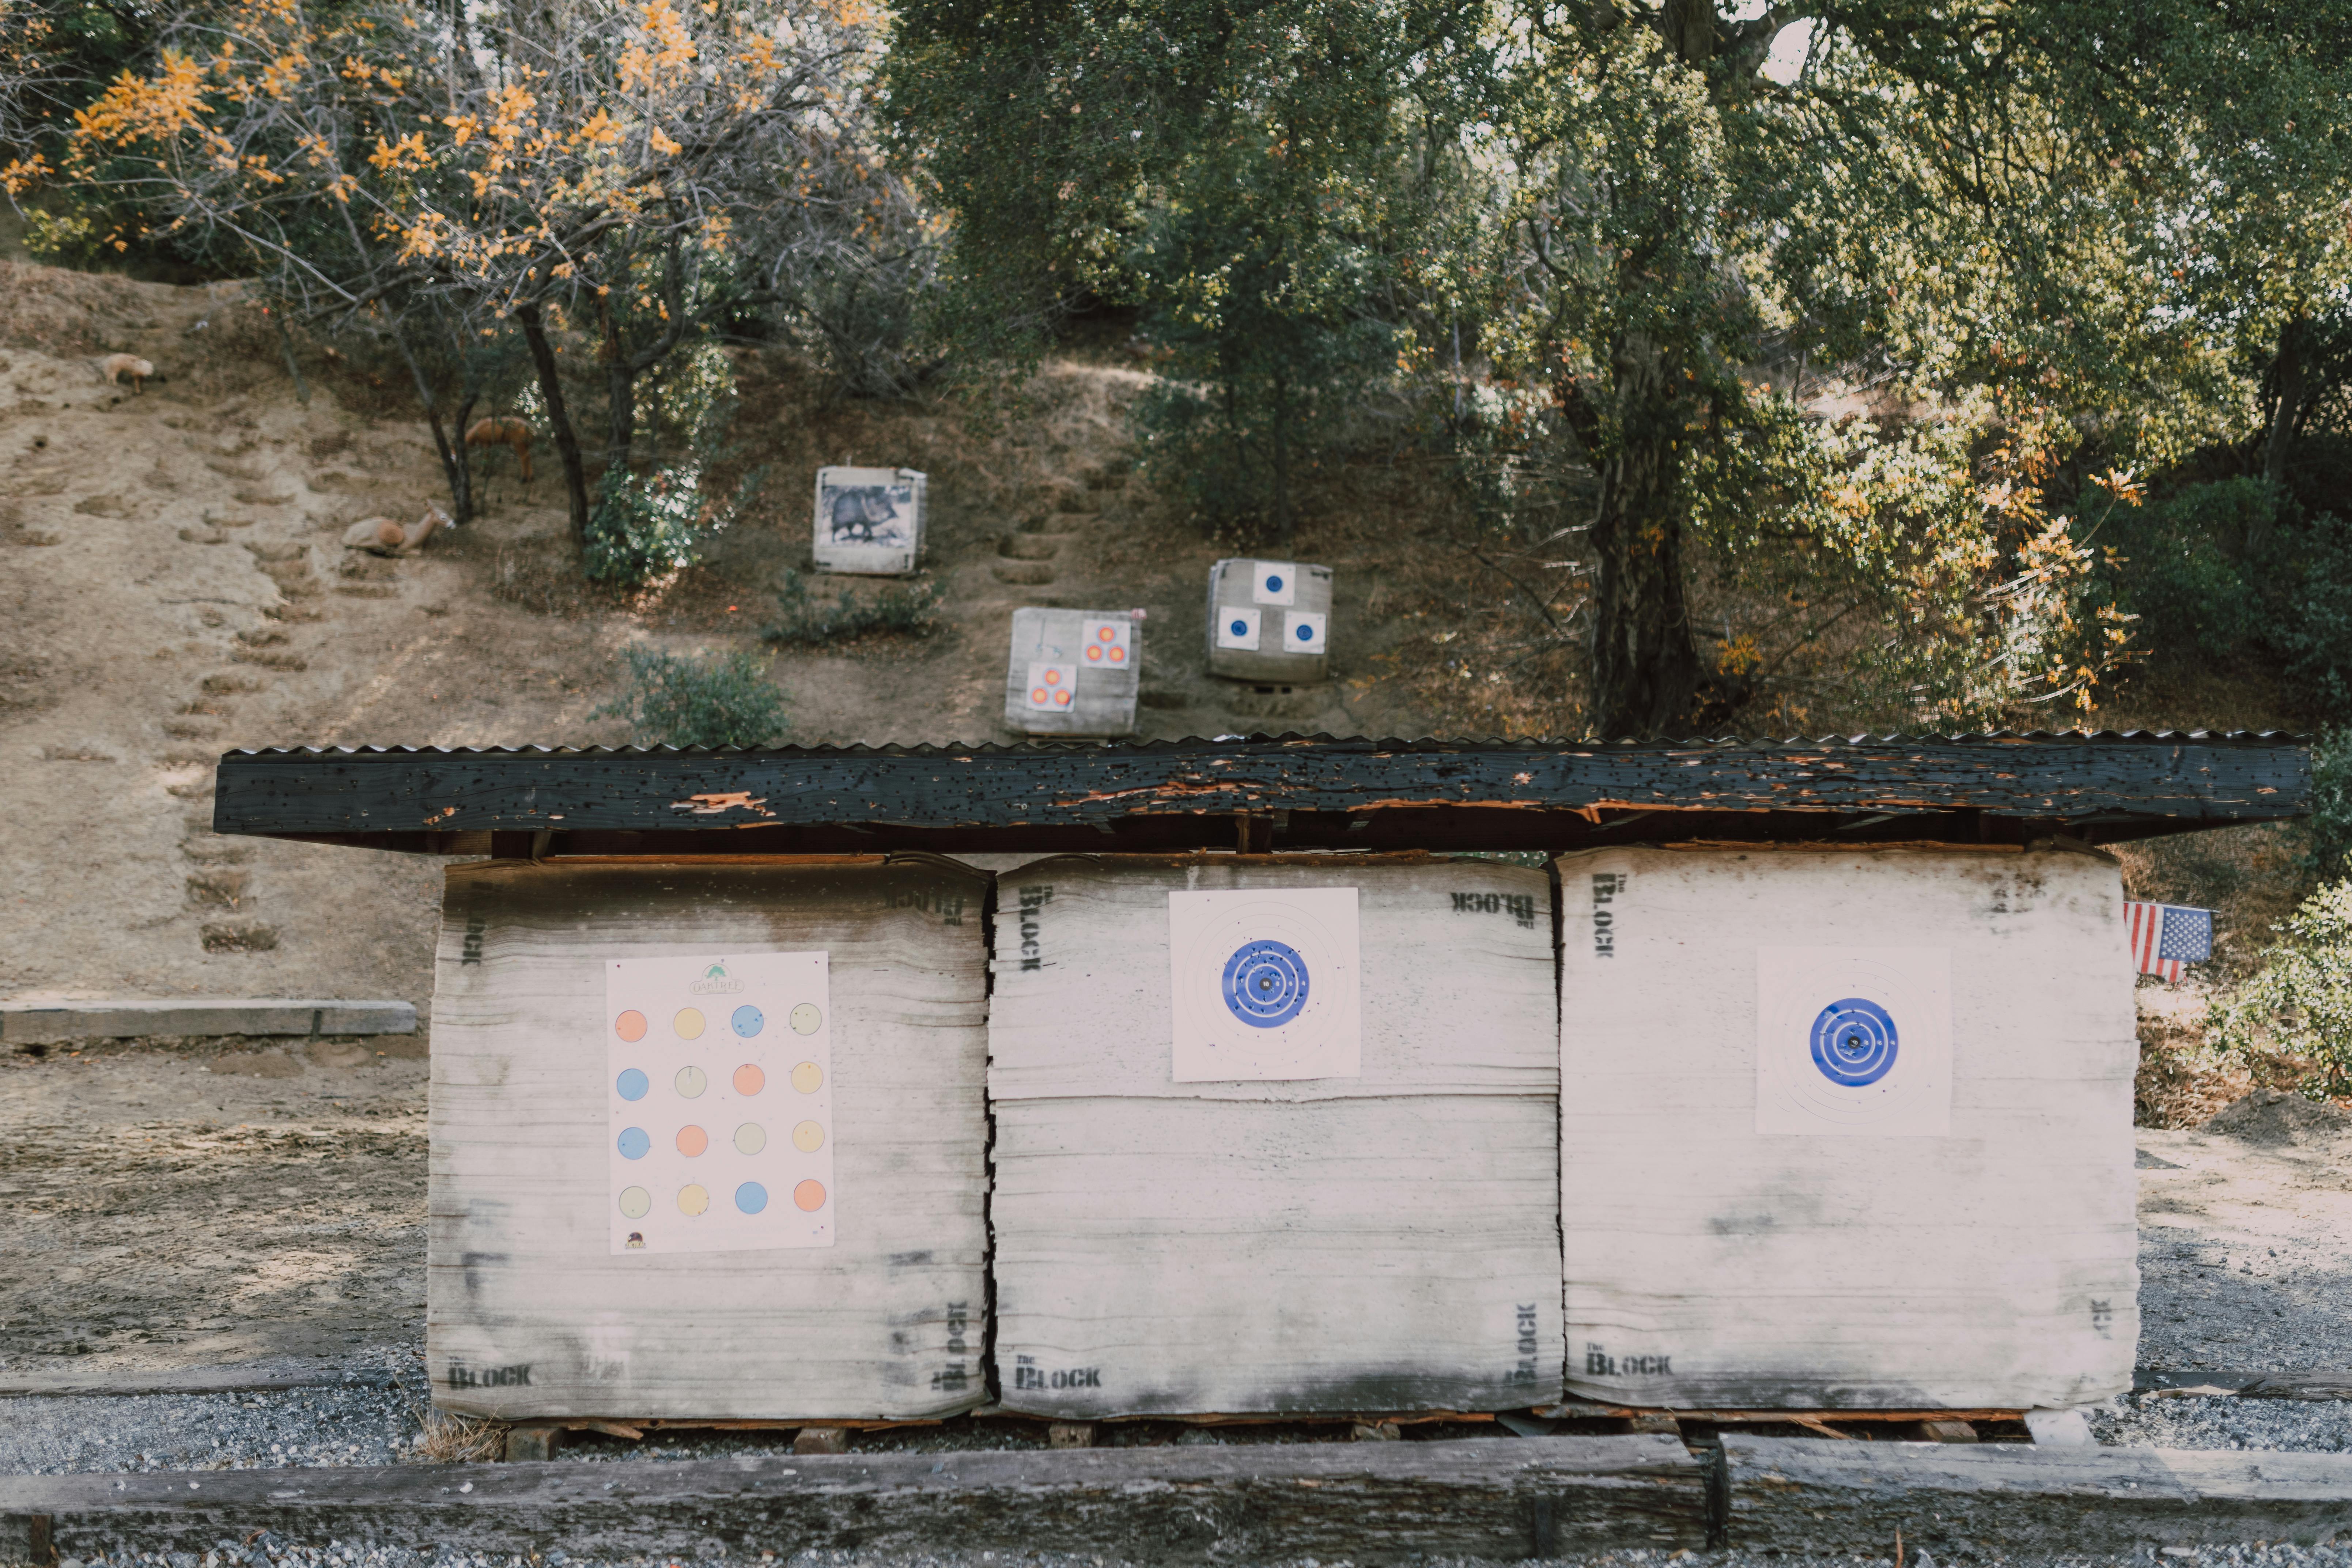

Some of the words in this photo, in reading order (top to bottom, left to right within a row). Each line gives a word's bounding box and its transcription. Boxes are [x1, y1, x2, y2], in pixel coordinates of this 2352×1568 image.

[1618, 874, 1627, 893] The
[1451, 892, 1535, 920] BLOCK
[1593, 874, 1616, 958] BLOCK
[1020, 886, 1042, 972] BLOCK
[693, 981, 741, 992] OAKTREE
[942, 1301, 967, 1391] BLOCK
[1514, 1304, 1538, 1388] BLOCK
[449, 1363, 533, 1390] BLOCK
[1587, 1353, 1673, 1376] BLOCK
[1016, 1367, 1101, 1390] BLOCK
